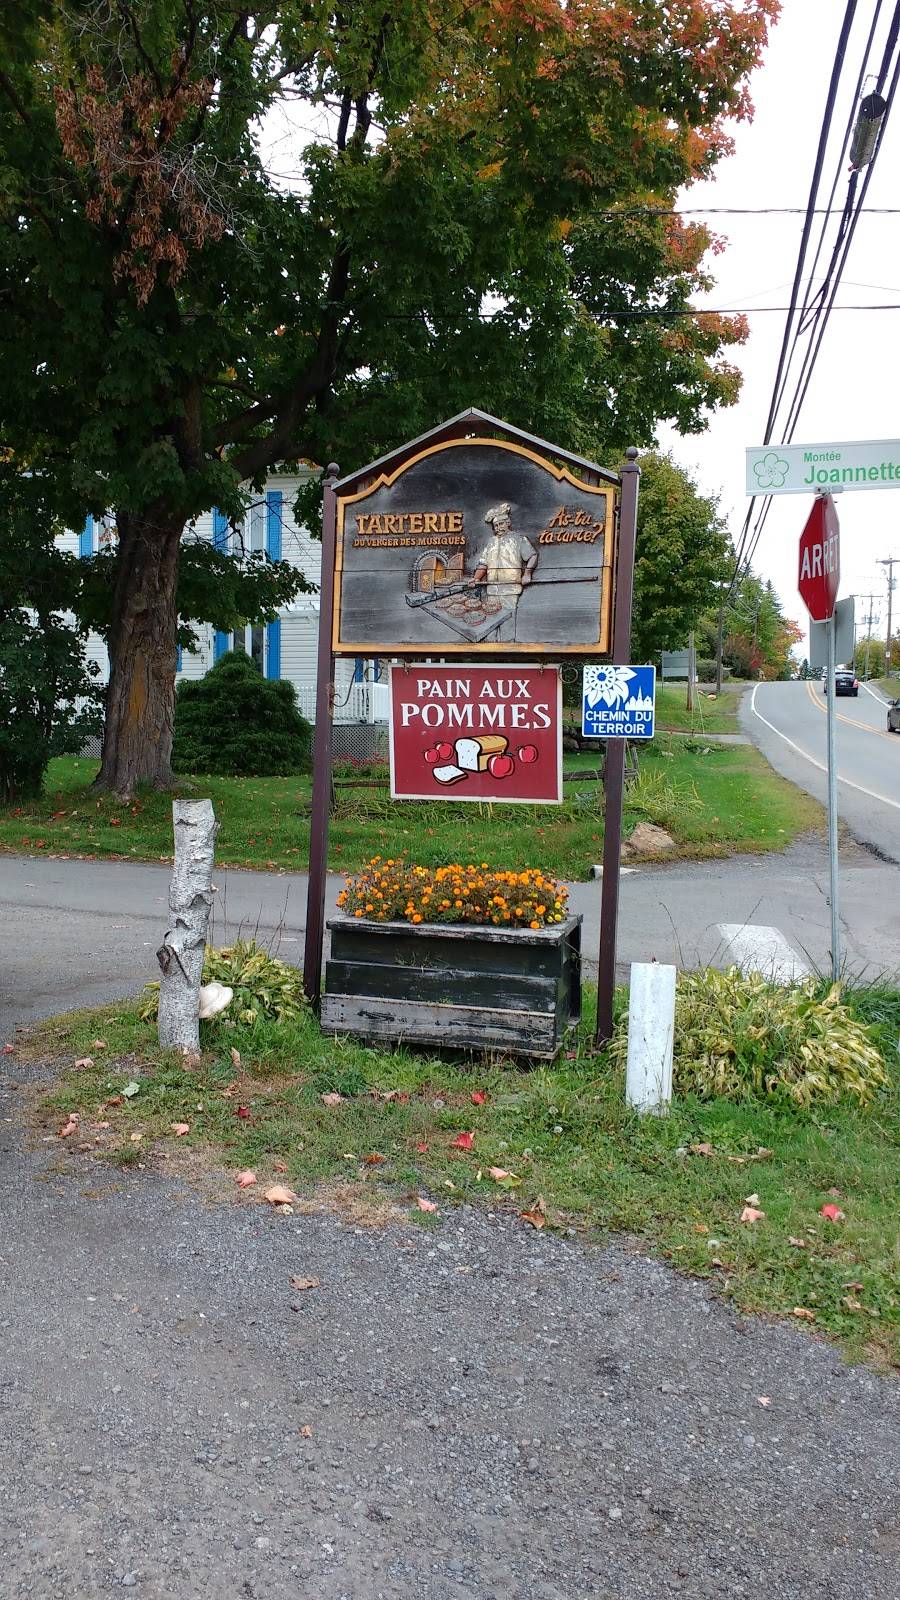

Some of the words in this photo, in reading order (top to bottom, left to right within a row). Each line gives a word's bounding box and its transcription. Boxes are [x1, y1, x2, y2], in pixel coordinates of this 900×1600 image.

[804, 451, 841, 462] Montée
[355, 512, 463, 535] TARTERIE
[549, 505, 592, 528] As-tu
[354, 539, 365, 547] DU
[367, 538, 399, 547] VERGER
[400, 538, 416, 546] DES
[418, 536, 466, 546] MUSIQUES
[416, 679, 472, 698] PAIN
[479, 679, 532, 698] AUX
[401, 703, 551, 729] POMMES
[585, 710, 630, 721] CHEMIN
[635, 711, 652, 722] DU
[591, 722, 646, 734] TERROIR
